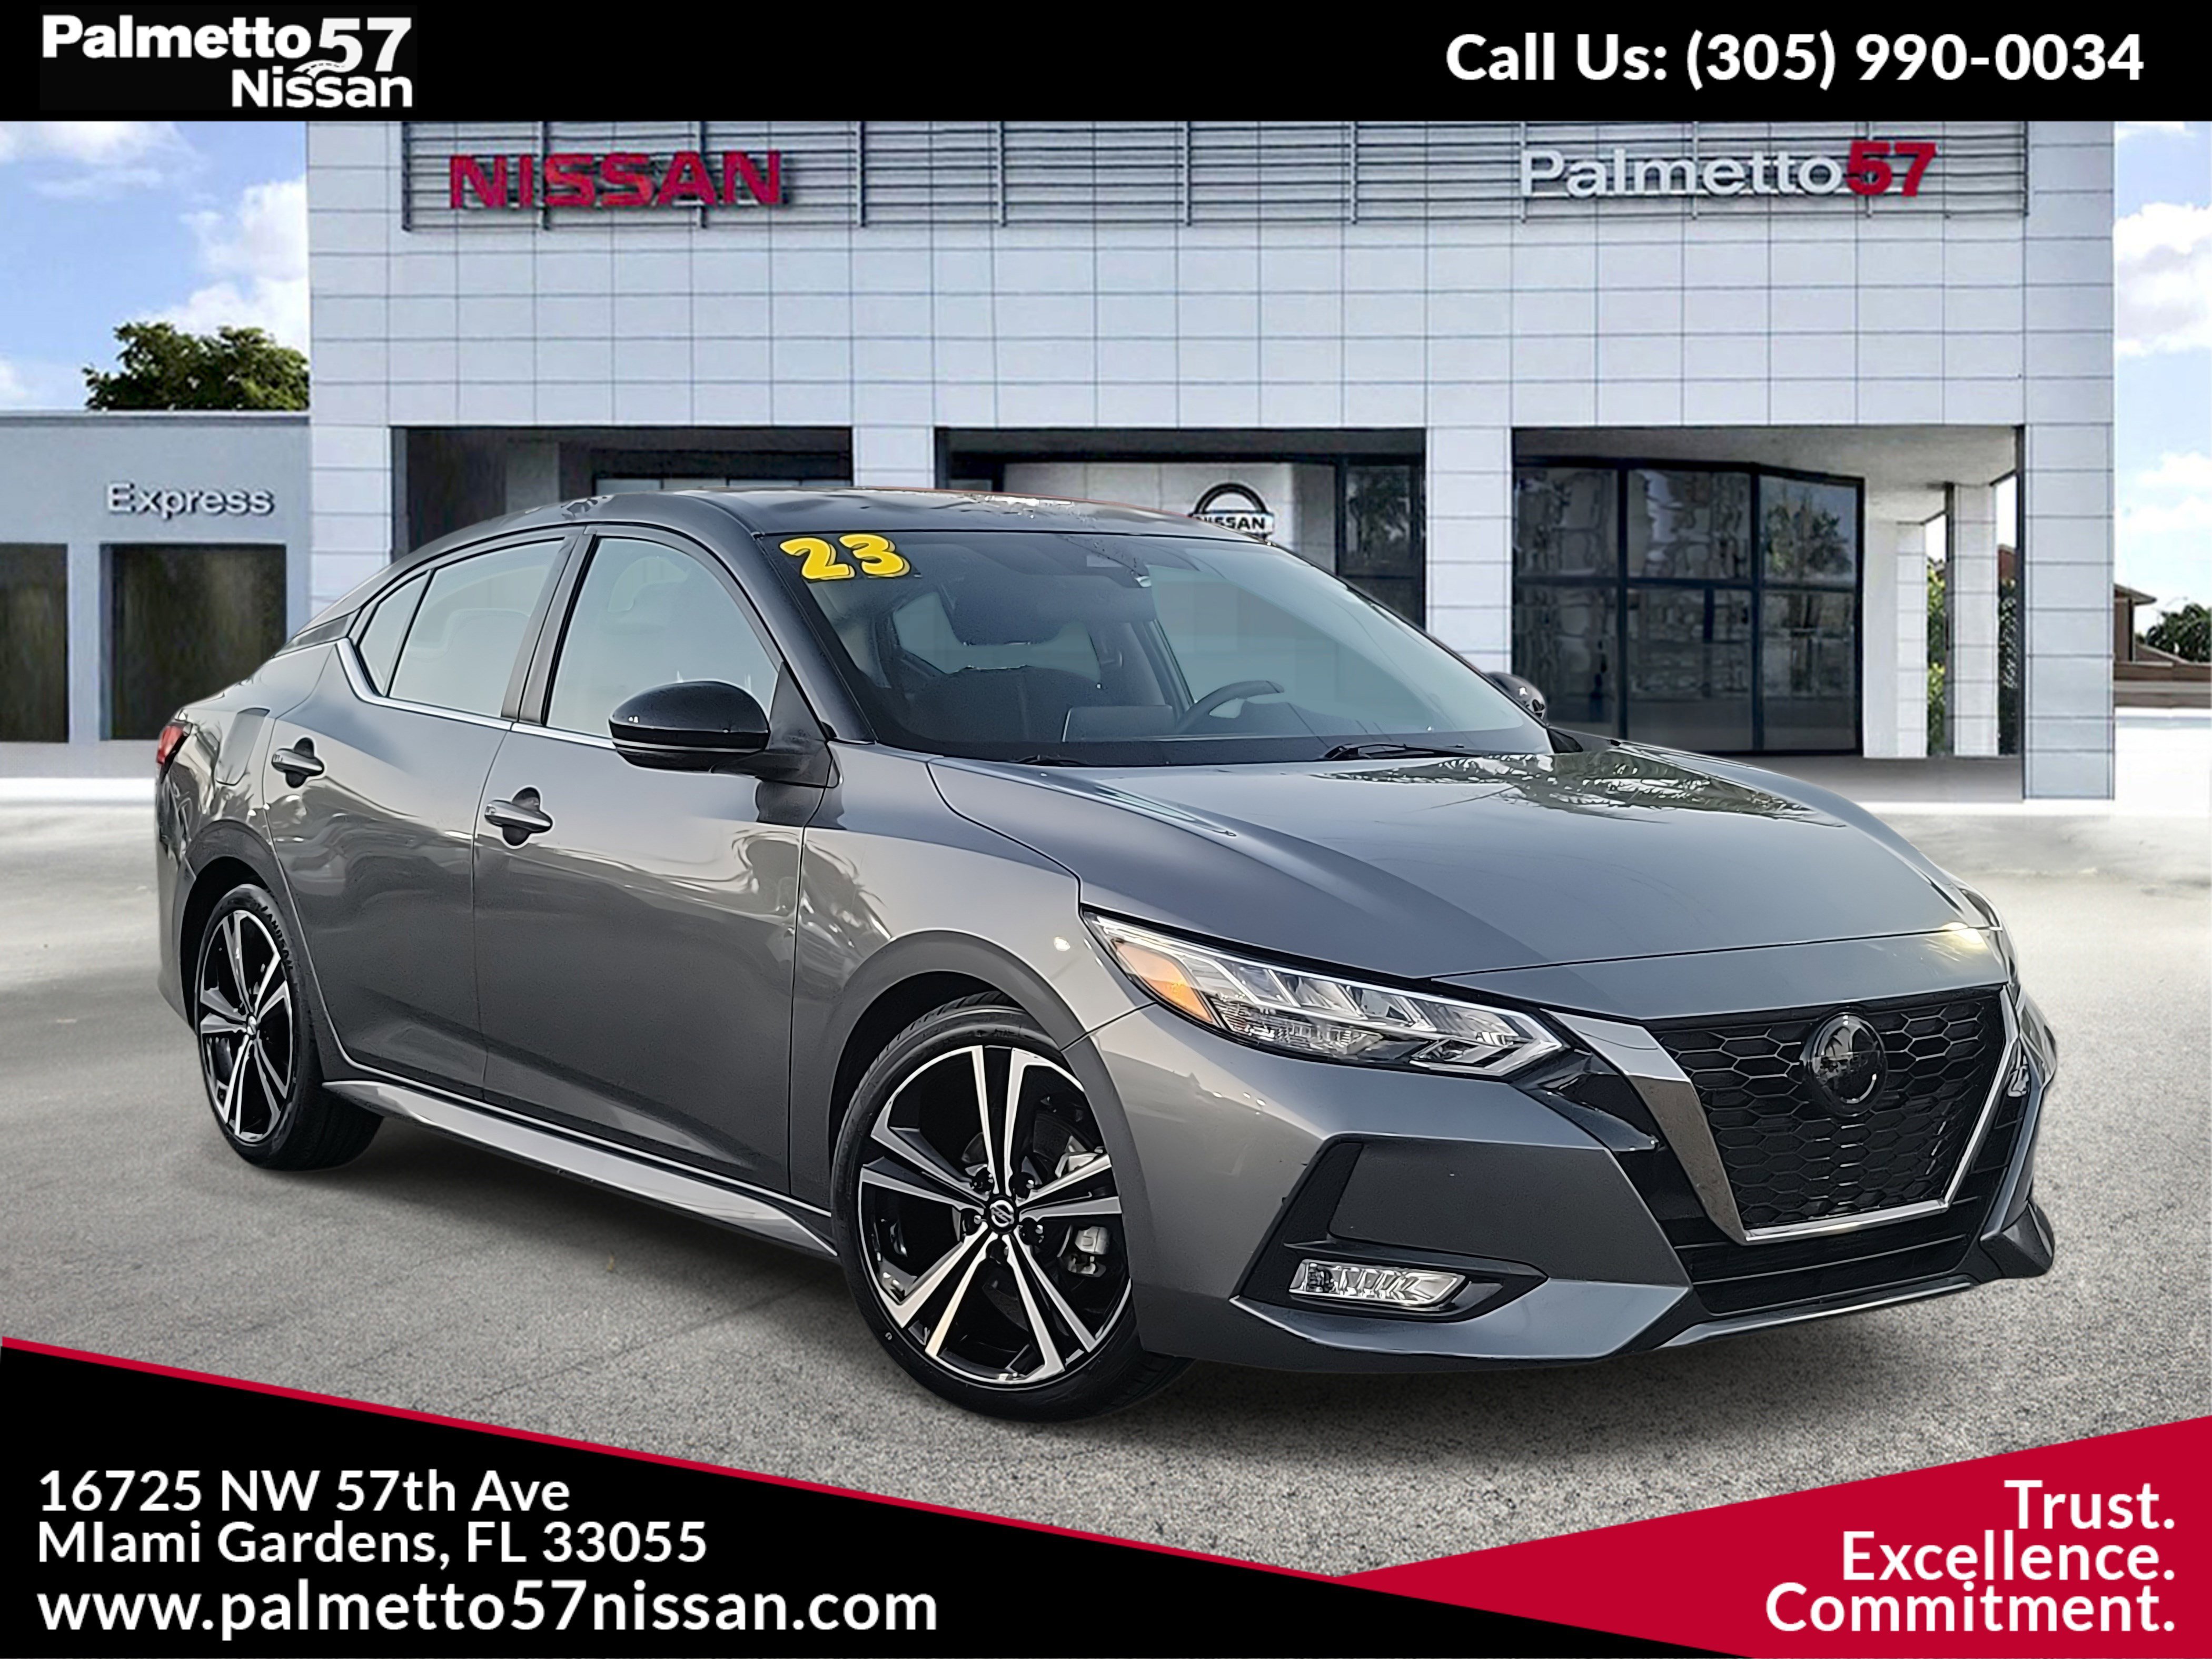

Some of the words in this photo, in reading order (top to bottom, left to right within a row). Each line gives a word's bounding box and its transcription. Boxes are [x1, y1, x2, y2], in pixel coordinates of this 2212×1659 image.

[450, 151, 781, 209] NISSAN
[107, 483, 274, 520] Express
[1196, 516, 1265, 529] SSAN
[778, 534, 911, 580] 23
